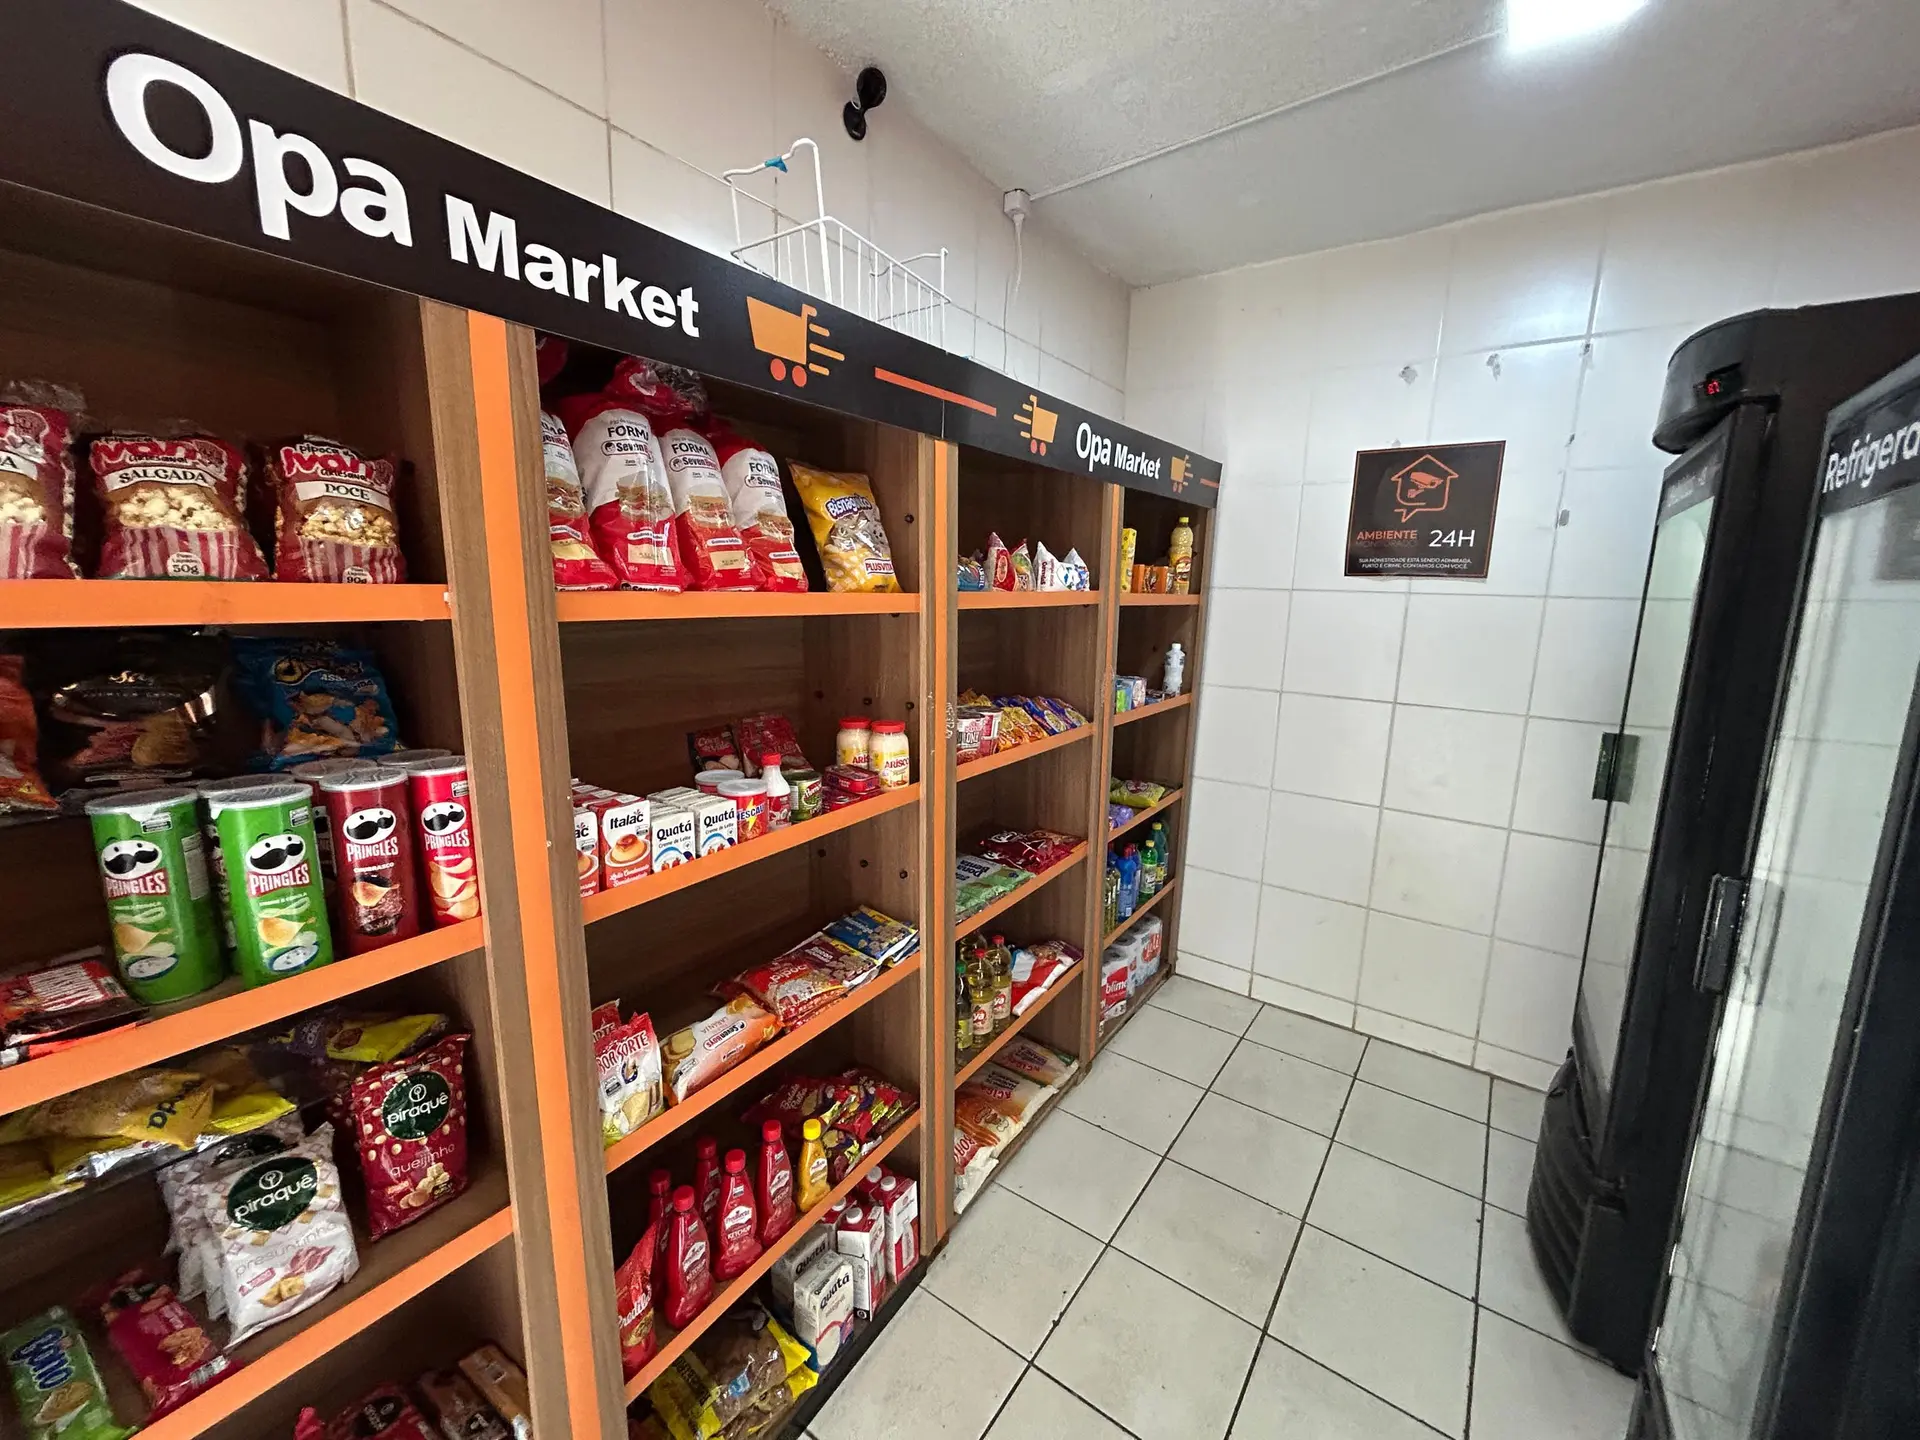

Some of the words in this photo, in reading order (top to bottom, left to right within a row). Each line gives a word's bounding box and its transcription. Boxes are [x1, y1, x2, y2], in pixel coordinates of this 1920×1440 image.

[106, 53, 413, 247] Opa
[445, 193, 699, 338] Market
[1076, 422, 1110, 472] Opa
[1114, 443, 1161, 480] Market
[118, 467, 208, 484] SALGADA
[324, 483, 371, 501] DOCE
[1356, 529, 1417, 540] AMBIENTE
[1428, 529, 1476, 548] 24H
[610, 813, 644, 830] Italac
[656, 820, 692, 842] Quatá
[703, 808, 735, 828] Quatá
[346, 836, 399, 862] PRINGLES
[424, 829, 470, 851] PRINGLES
[105, 871, 167, 897] PRINGLES
[247, 863, 310, 896] PRINGLES
[770, 963, 808, 984] pipoc
[616, 1030, 649, 1061] SORTE
[387, 1092, 449, 1127] piraquê
[390, 1143, 455, 1177] queijinho
[234, 1174, 314, 1222] piraquê
[820, 1272, 850, 1310] Quatá
